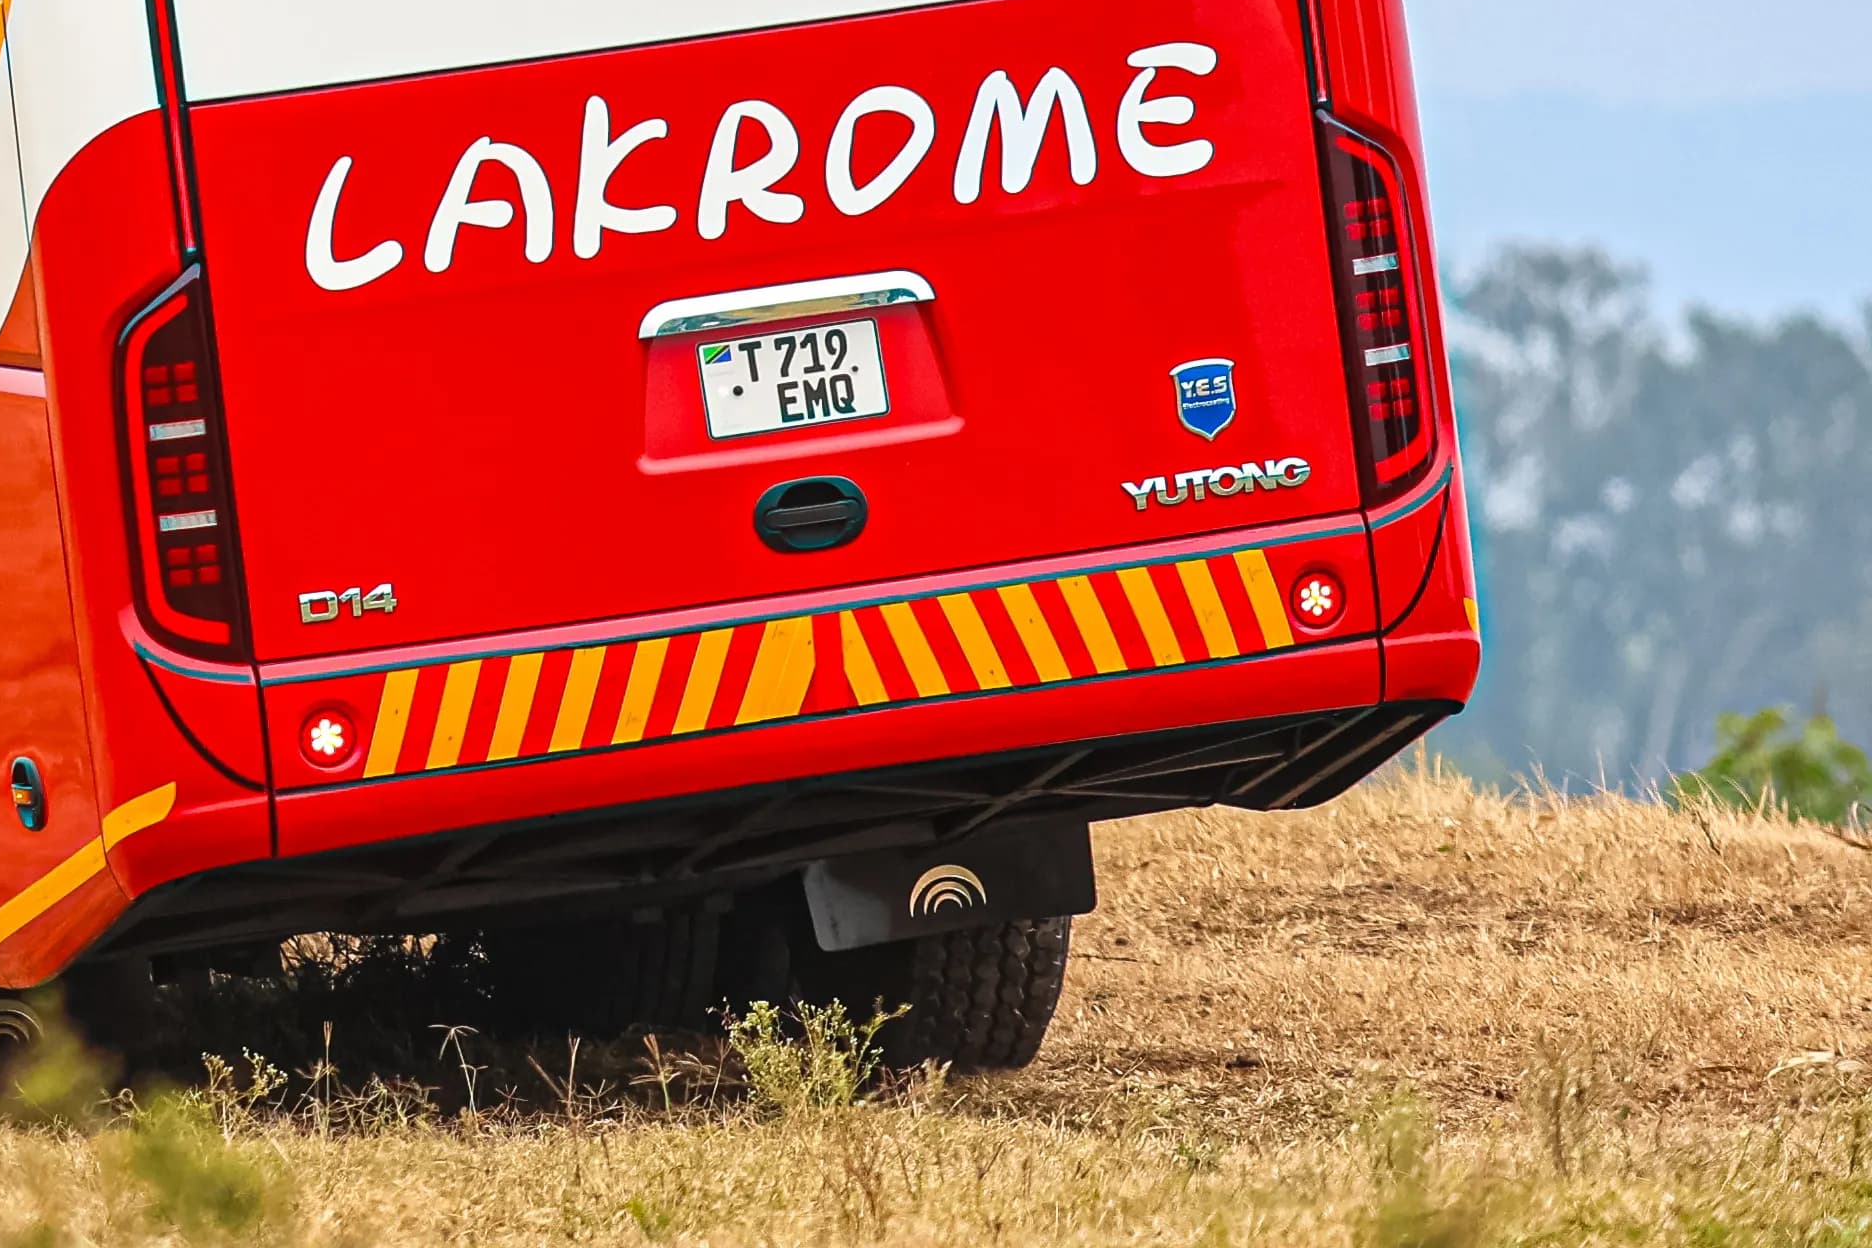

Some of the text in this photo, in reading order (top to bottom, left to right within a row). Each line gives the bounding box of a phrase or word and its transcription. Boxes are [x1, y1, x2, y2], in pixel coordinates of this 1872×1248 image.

[305, 41, 1218, 291] LAKROME
[738, 329, 848, 382] T 719
[778, 376, 856, 422] EMQ
[1122, 456, 1312, 510] YUTONG
[298, 583, 398, 624] D14
